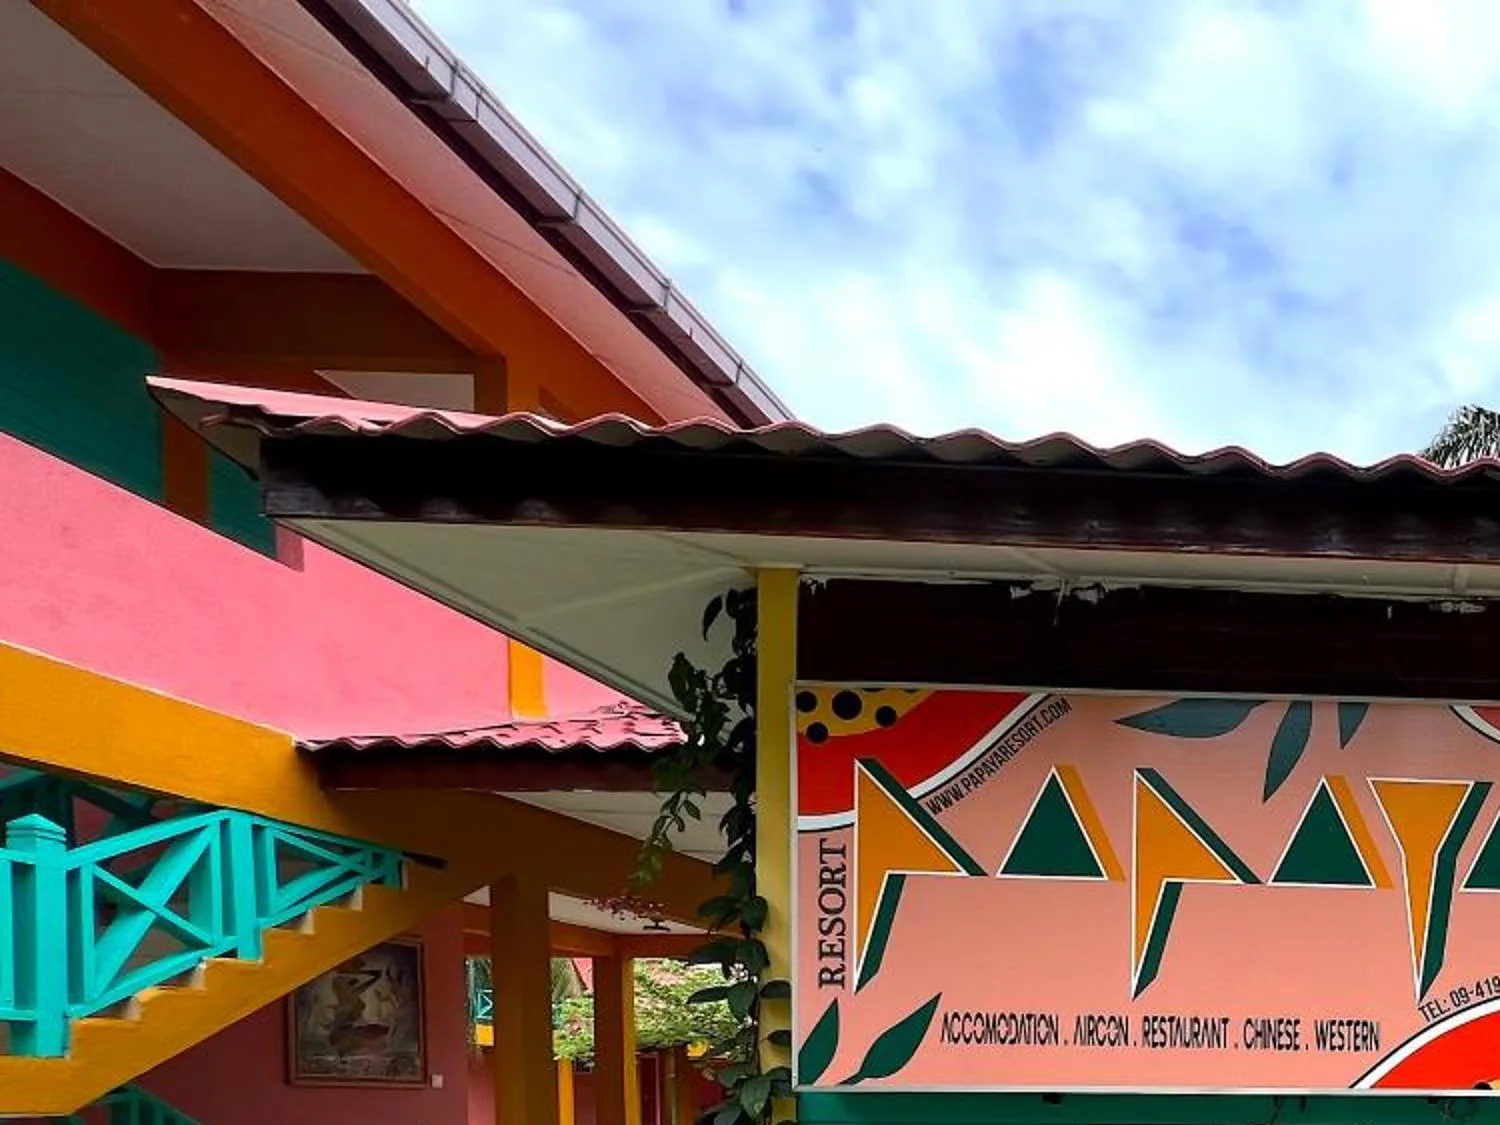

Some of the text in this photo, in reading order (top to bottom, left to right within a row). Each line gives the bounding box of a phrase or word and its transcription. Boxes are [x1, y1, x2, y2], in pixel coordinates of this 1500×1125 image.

[925, 697, 1073, 816] WWW.PAPAYARESORT.COM
[818, 838, 846, 989] RESORT
[940, 1012, 1379, 1050] ACCOMODATION AIRCON RESTAURANT CHINESE WESTERN
[1418, 999, 1450, 1022] TEL:
